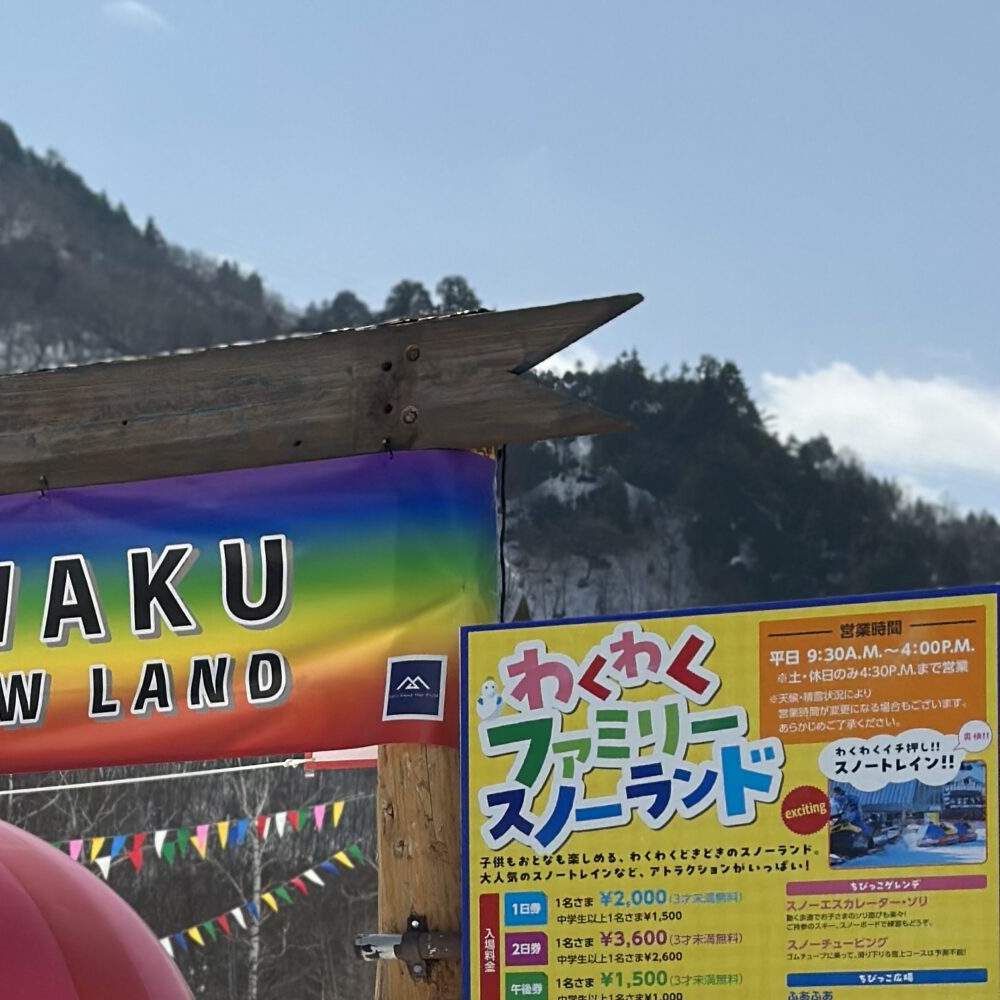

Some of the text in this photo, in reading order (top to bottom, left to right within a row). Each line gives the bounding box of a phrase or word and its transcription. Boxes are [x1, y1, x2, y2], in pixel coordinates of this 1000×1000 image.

[840, 620, 903, 639] 営業時間
[769, 649, 800, 666] 平日
[507, 629, 713, 712] わくわく
[88, 650, 289, 718] LAND
[486, 703, 740, 788] ファミリー
[486, 744, 776, 848] スノーランド
[785, 801, 828, 820] exciting
[850, 879, 922, 892] ちびっこゲレンデ
[556, 897, 594, 908] 1名さま
[600, 889, 667, 908] ¥2,000
[512, 902, 542, 915] 1日券
[512, 942, 542, 955] 2日券
[557, 937, 594, 948] 1名さま
[600, 930, 668, 948] ¥3,600
[787, 936, 888, 950] スノーチュービング
[484, 928, 497, 973] 入場料金
[557, 977, 594, 989] 1名さま
[600, 970, 668, 988] ¥1,500
[859, 972, 914, 984] ちびっこ広場
[511, 983, 542, 996] 午後券
